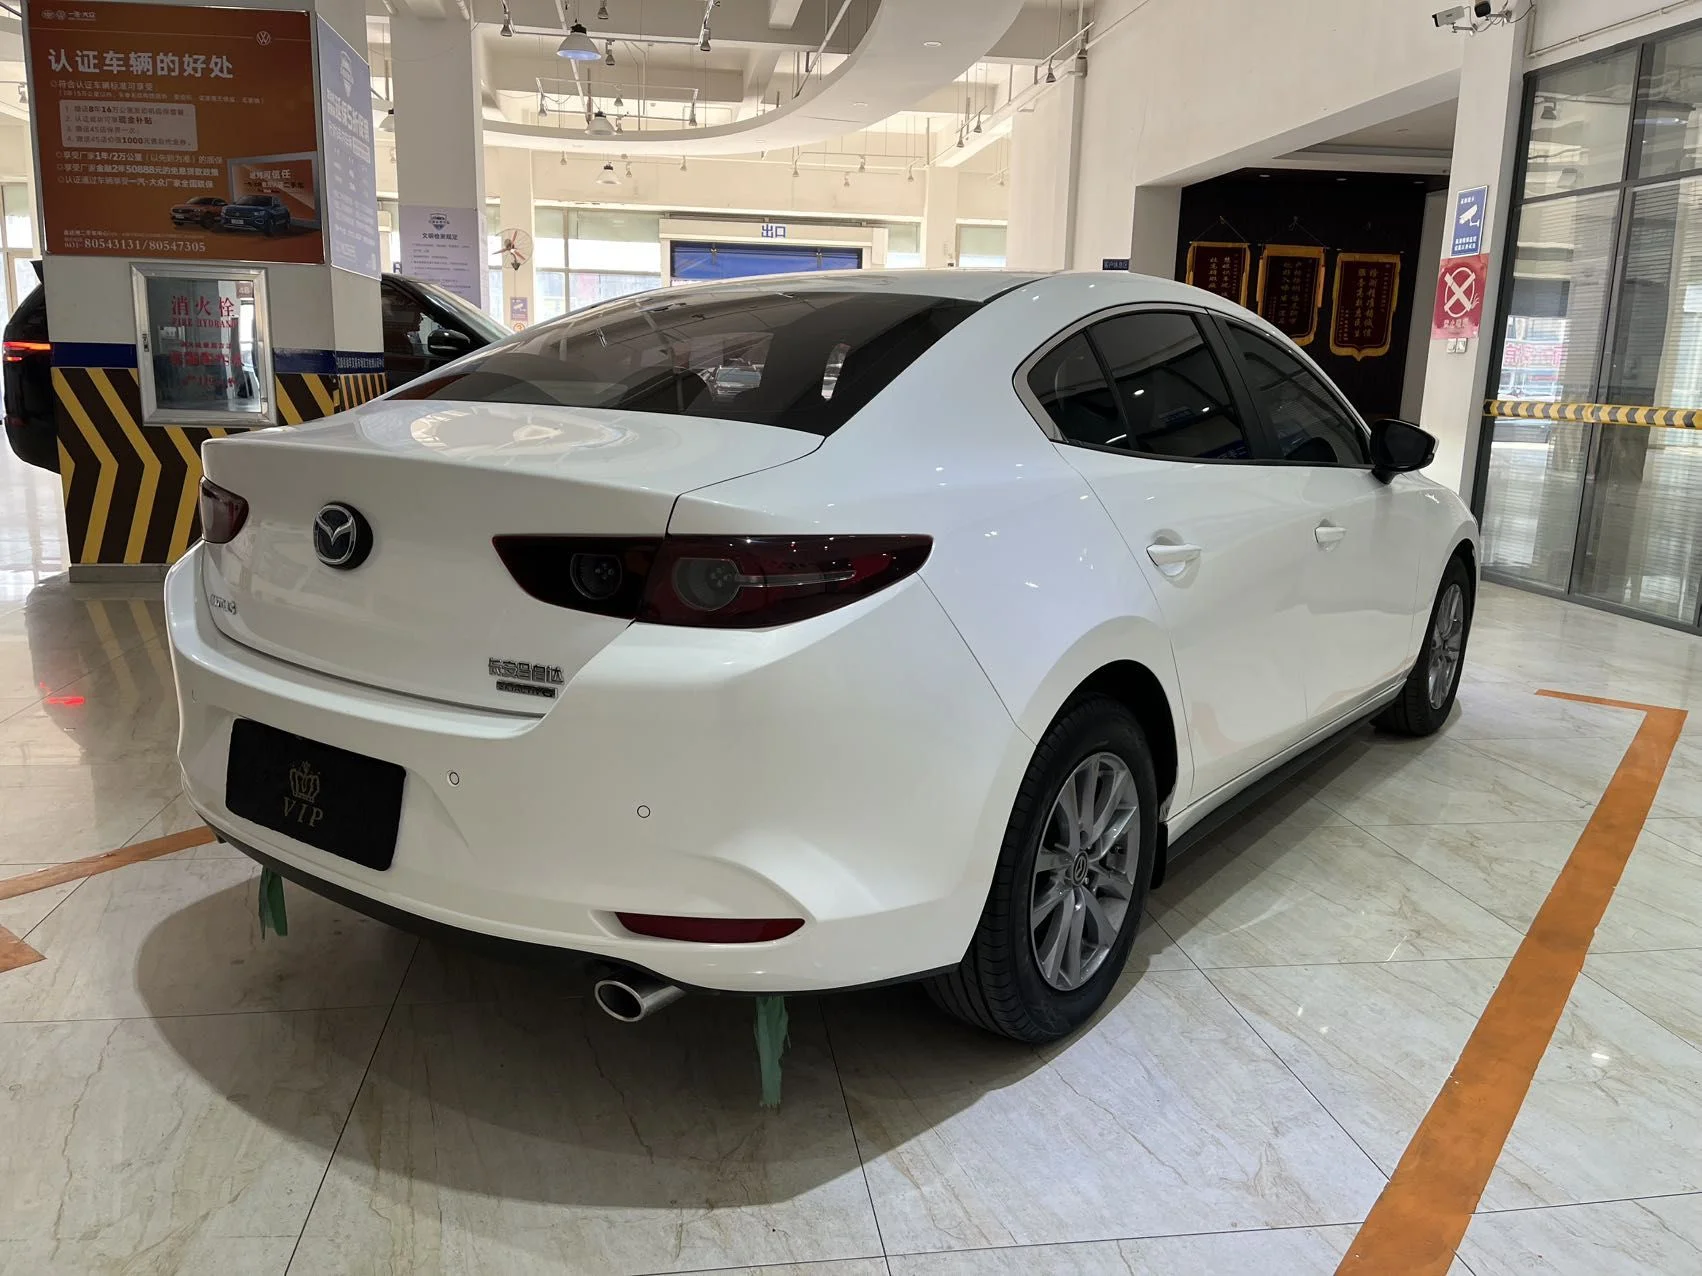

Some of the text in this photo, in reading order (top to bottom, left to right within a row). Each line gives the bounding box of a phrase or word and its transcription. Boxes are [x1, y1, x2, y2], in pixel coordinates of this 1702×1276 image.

[48, 49, 233, 79] 认证车辆的好处
[761, 224, 787, 239] 出口
[84, 238, 206, 252] 80543131/80547305
[171, 295, 235, 317] 消火栓
[488, 657, 564, 685] 长安马自达
[283, 796, 324, 828] VIP
